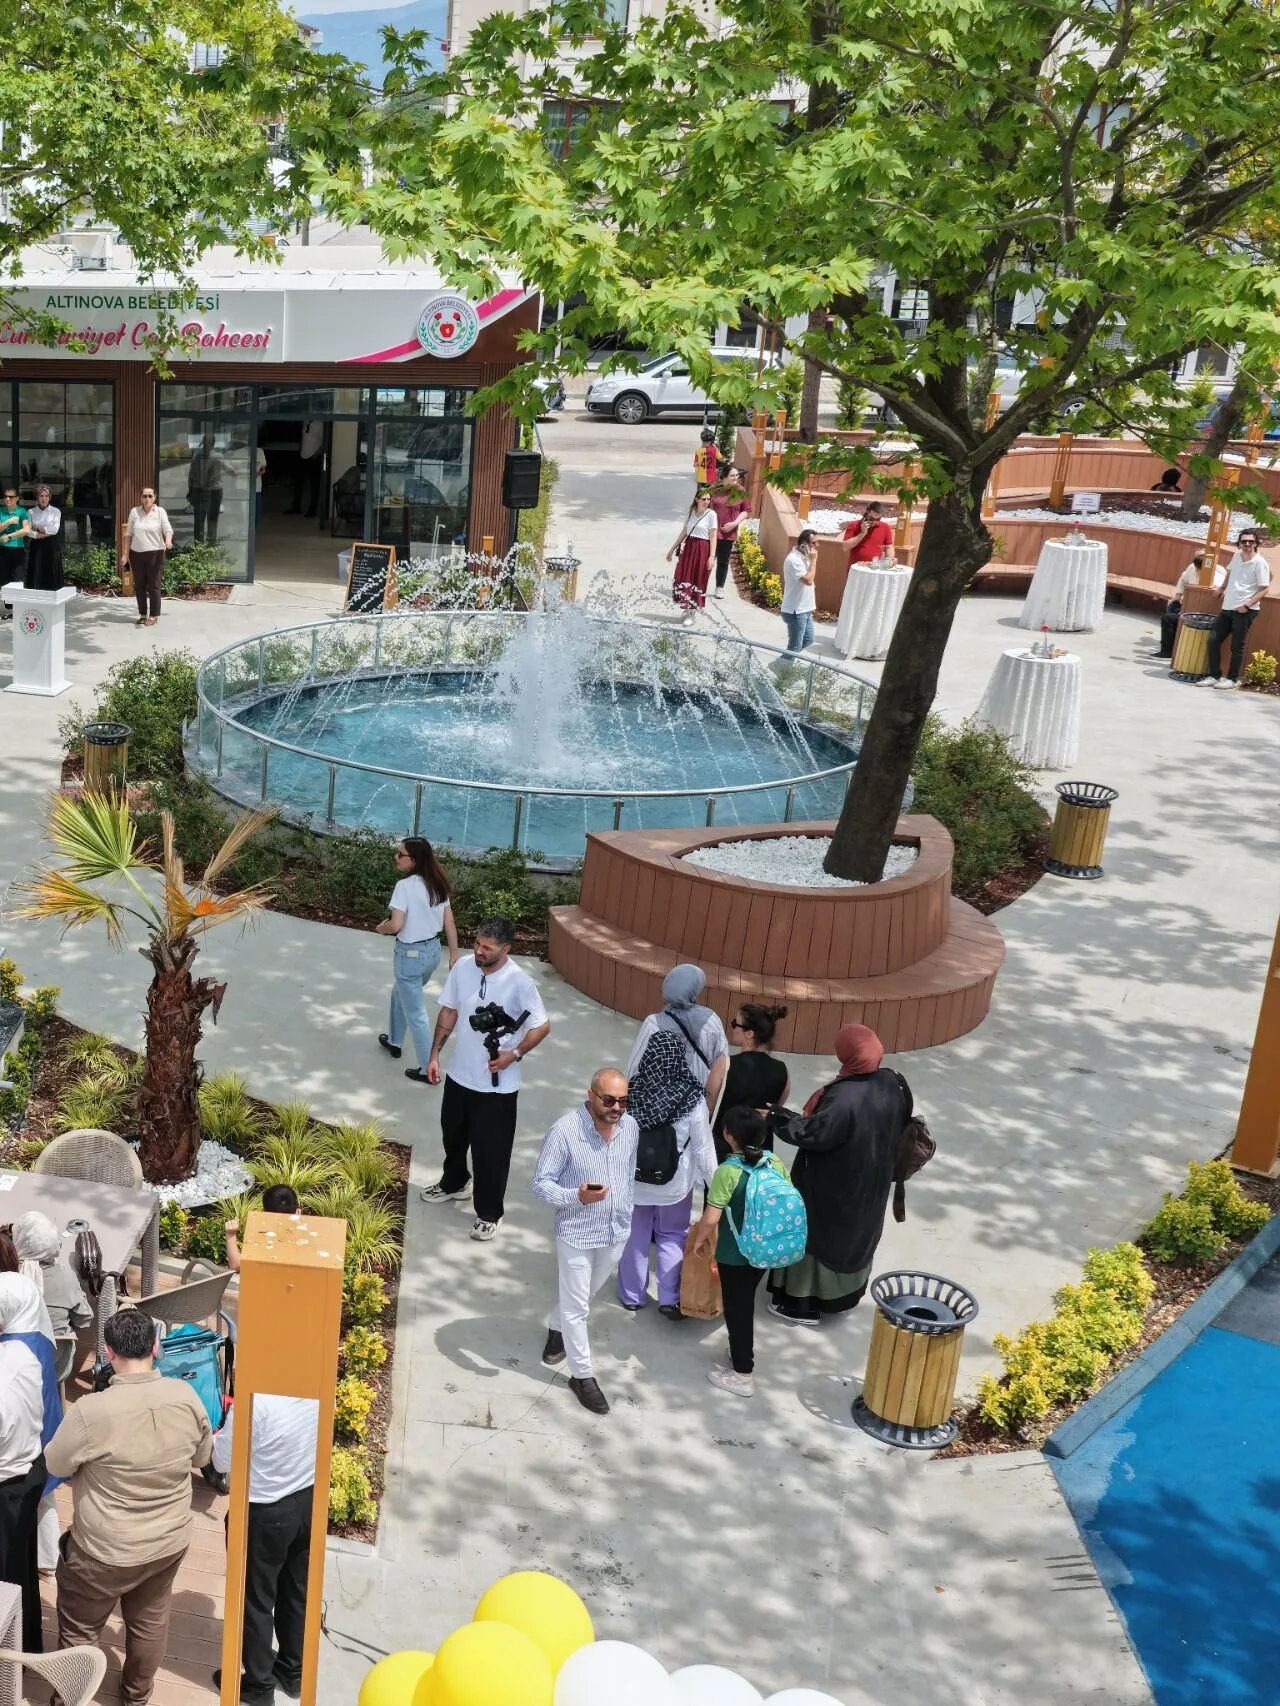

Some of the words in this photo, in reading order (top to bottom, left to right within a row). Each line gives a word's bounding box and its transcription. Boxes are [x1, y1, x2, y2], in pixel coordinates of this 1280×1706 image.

[46, 295, 124, 310] ALTINOVA
[181, 322, 272, 351] Bahçesi
[700, 457, 713, 470] 42
